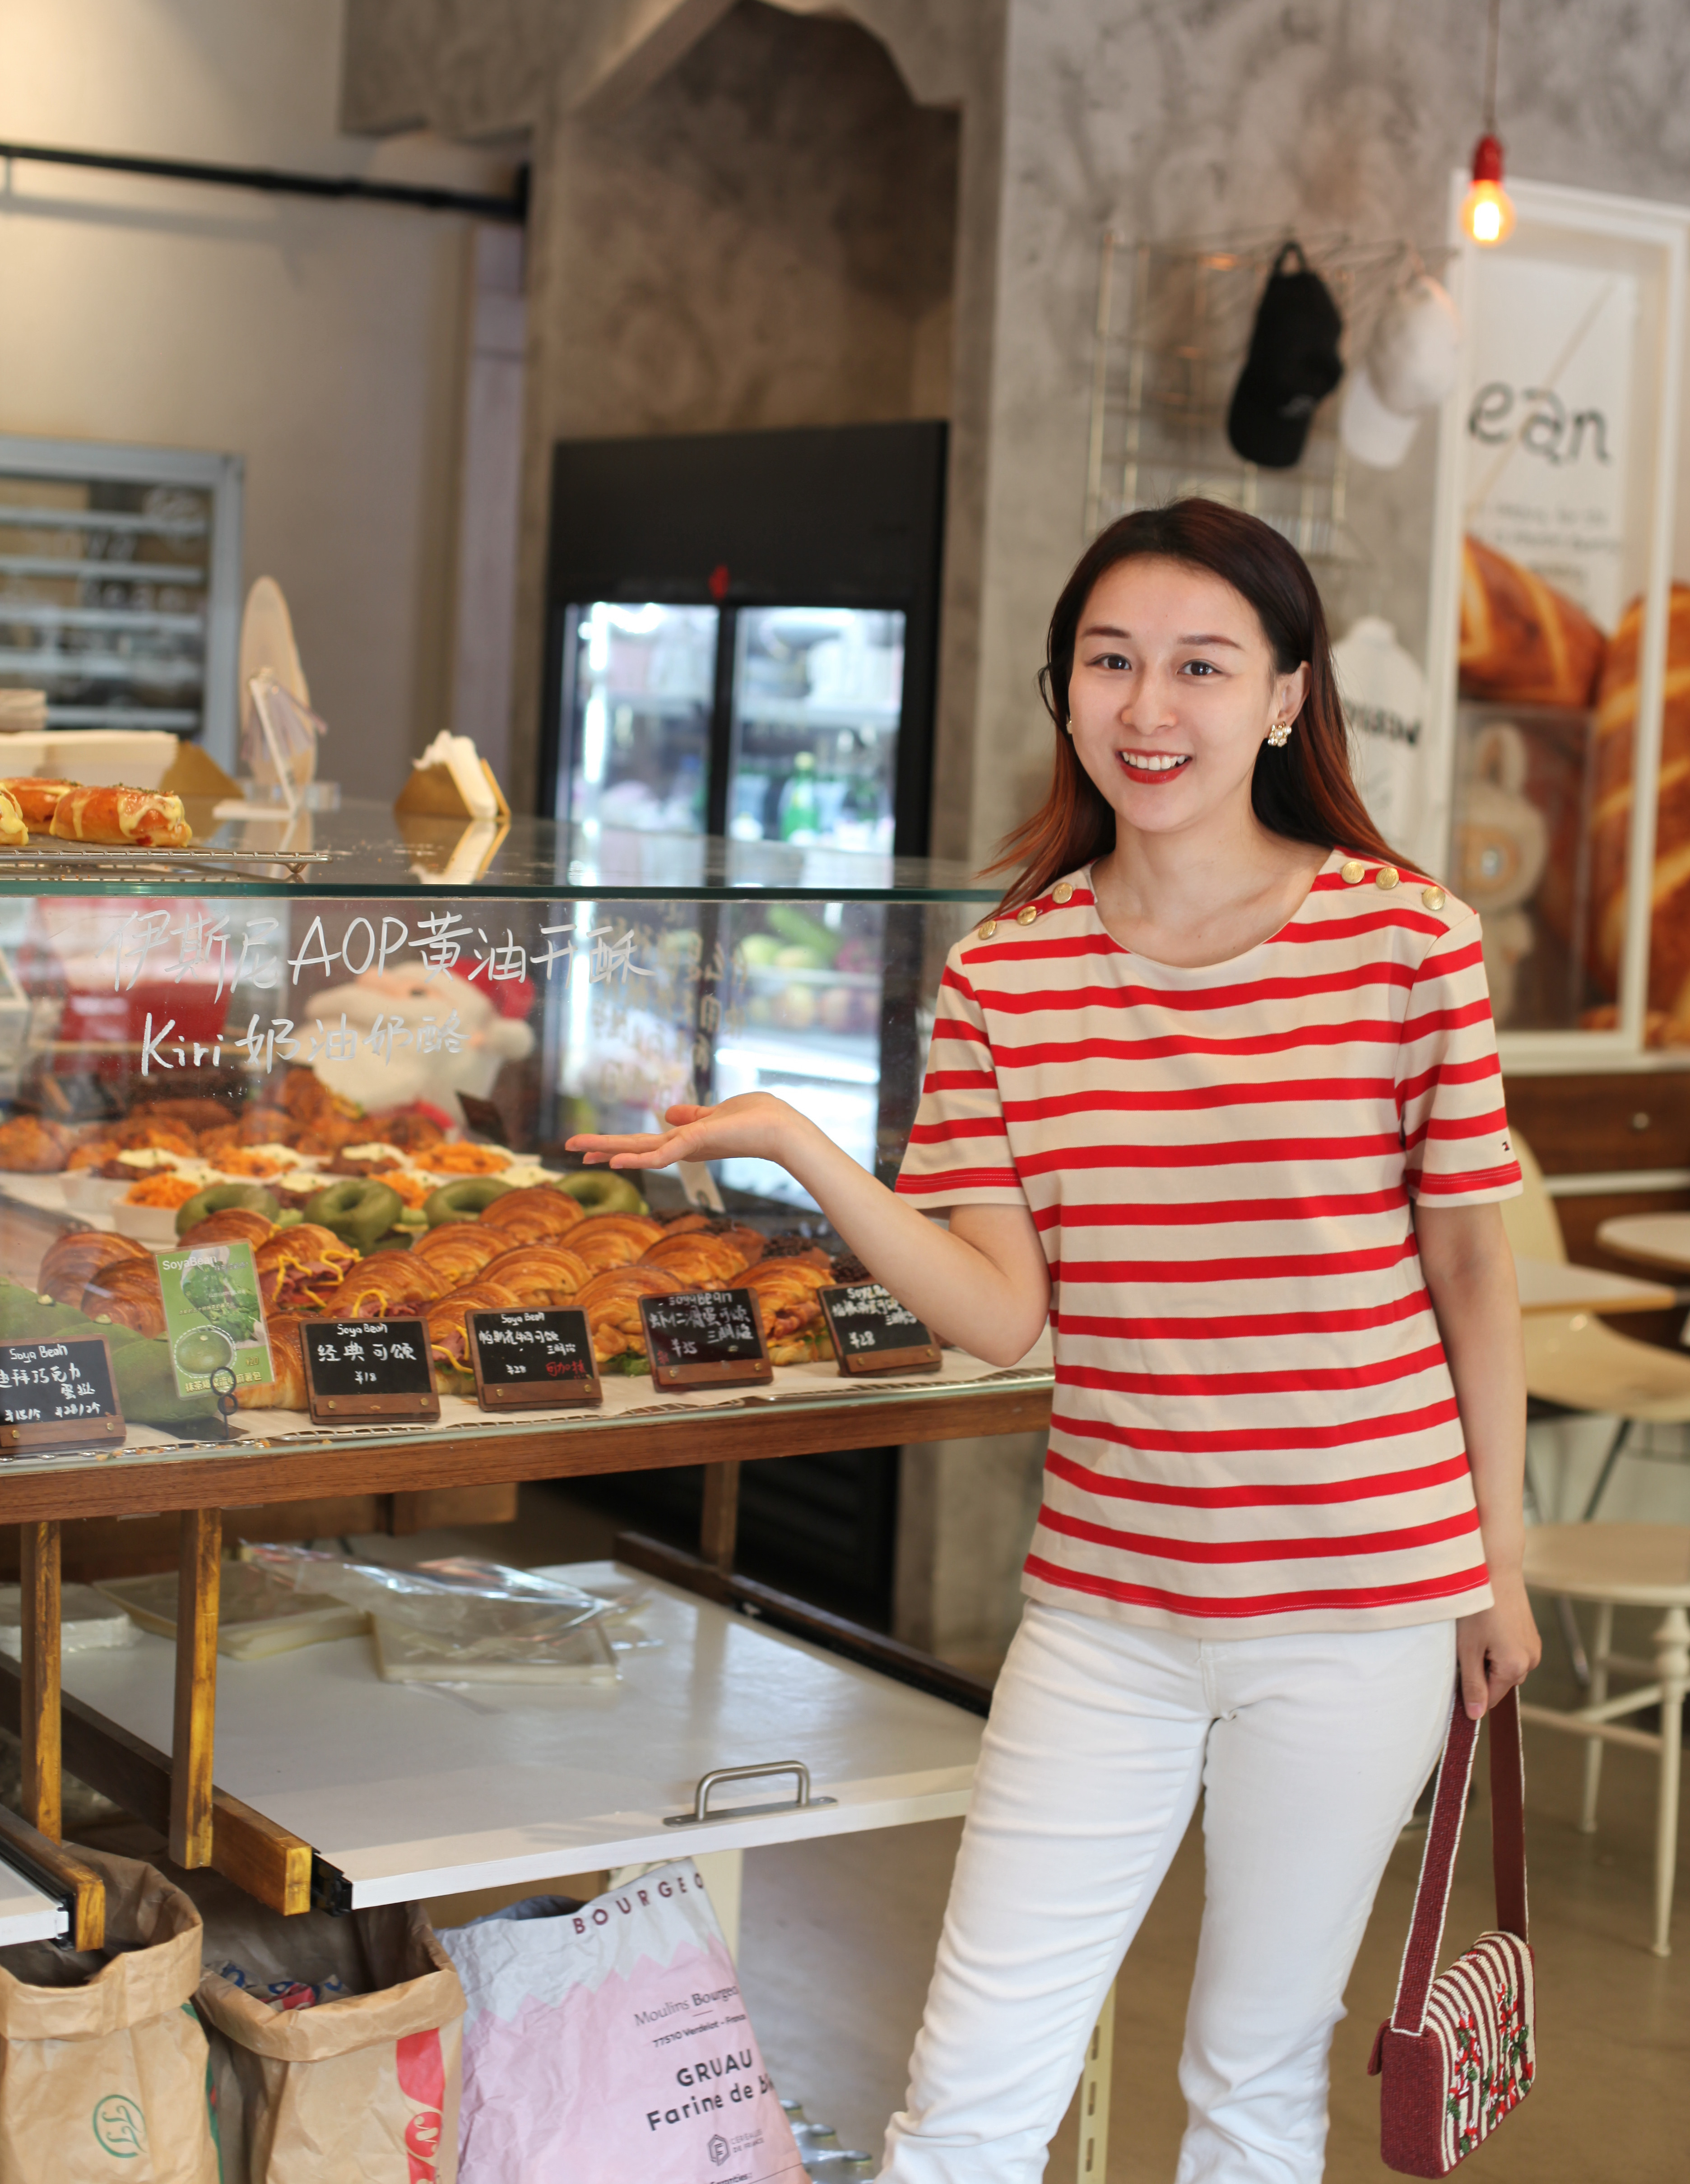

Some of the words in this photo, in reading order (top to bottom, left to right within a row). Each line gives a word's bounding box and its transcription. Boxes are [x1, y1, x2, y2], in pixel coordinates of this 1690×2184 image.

[162, 1256, 217, 1271] SoyaBean
[316, 1340, 418, 1362] 经典可颂
[245, 1356, 260, 1366] ¥20
[354, 1370, 377, 1385] ¥18
[677, 2049, 752, 2087] GRUAU
[646, 2095, 724, 2132] Farine
[730, 2082, 754, 2103] de
